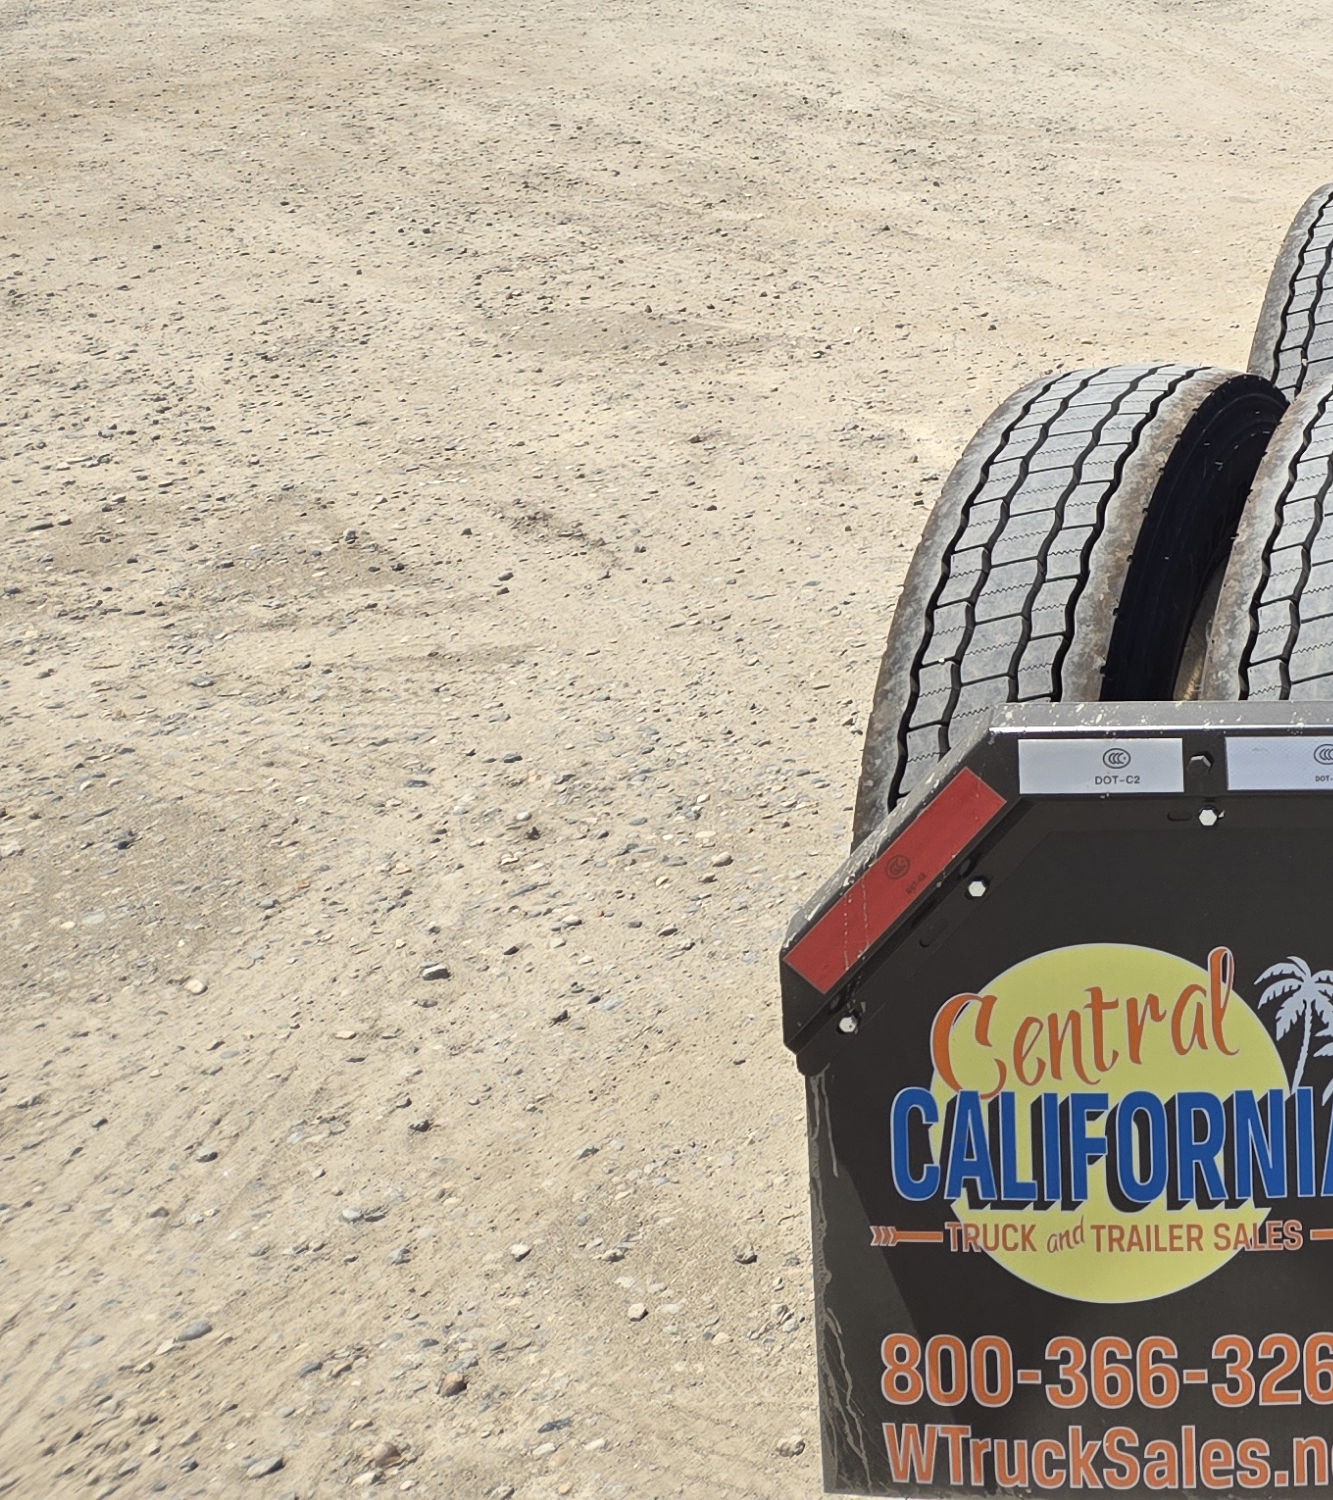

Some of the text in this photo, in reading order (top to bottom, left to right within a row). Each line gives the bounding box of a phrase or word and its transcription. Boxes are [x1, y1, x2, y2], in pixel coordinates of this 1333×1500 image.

[1095, 775, 1141, 785] DOT-C2
[932, 946, 1240, 1099] Central
[945, 1214, 1304, 1254] TRUCK and TRAILER SALES
